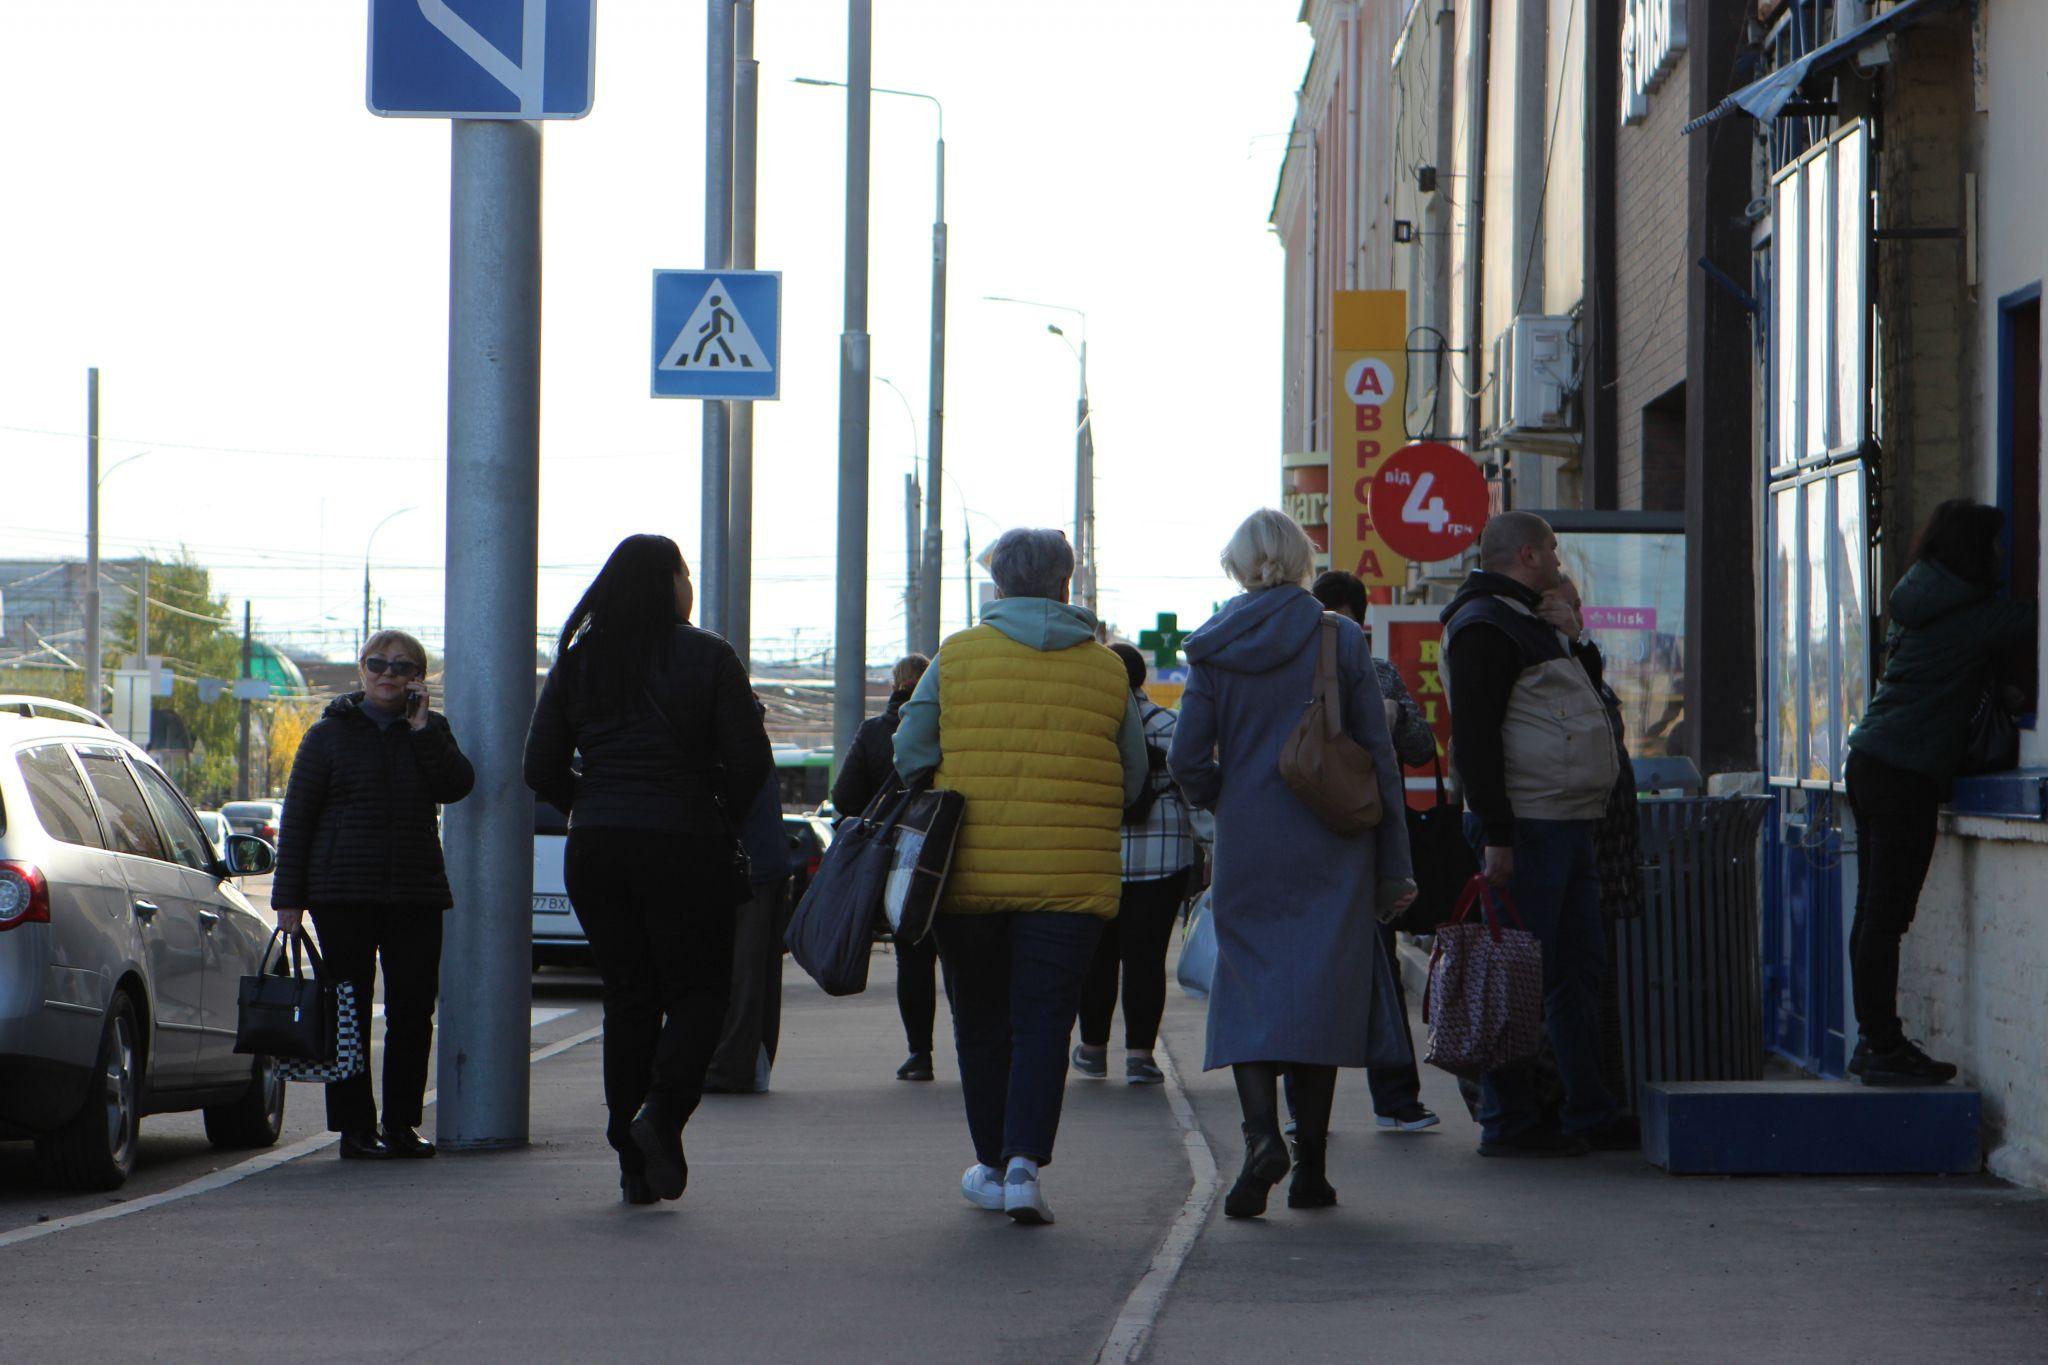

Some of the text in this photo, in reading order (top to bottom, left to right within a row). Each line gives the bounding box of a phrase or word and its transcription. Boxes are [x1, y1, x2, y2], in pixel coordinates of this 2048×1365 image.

[1385, 468, 1473, 537] від 4 грн
[1418, 640, 1444, 757] ВХІ
